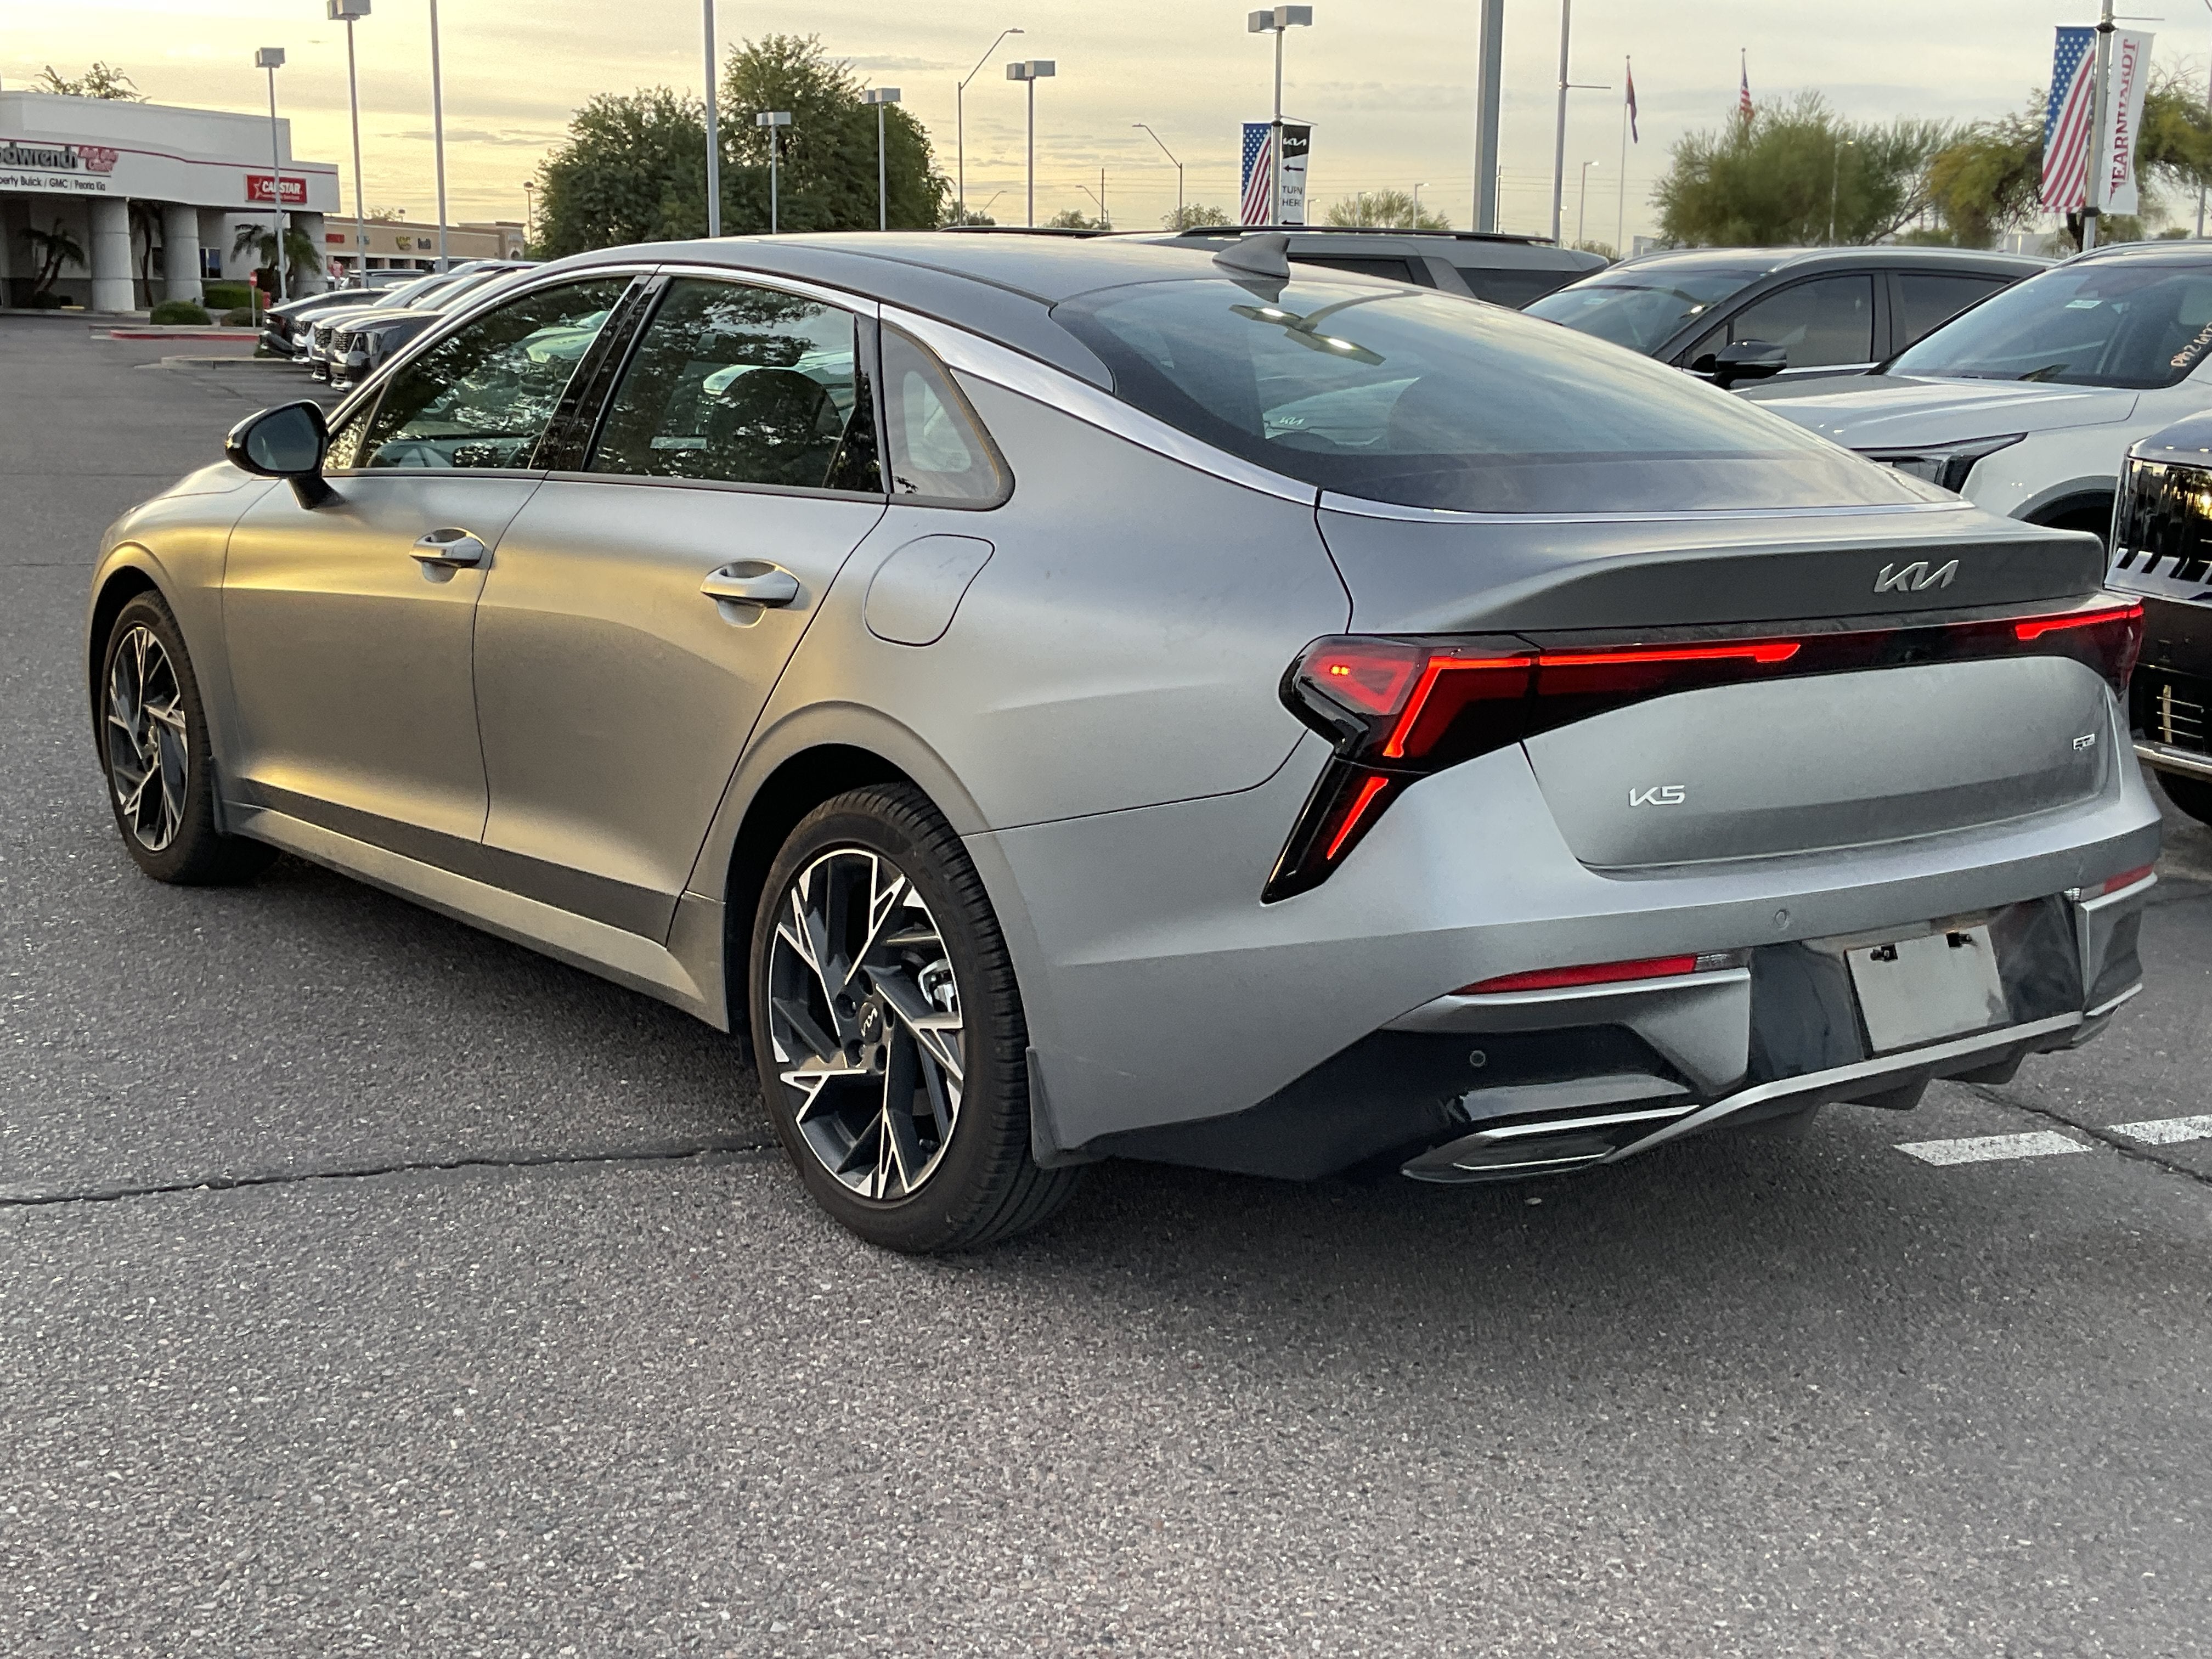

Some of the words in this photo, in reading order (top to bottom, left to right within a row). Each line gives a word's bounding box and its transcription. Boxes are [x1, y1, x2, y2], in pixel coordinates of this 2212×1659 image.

[49, 178, 68, 189] GMC
[262, 180, 301, 194] CASTAR
[1874, 560, 1959, 592] KIA
[1629, 785, 1685, 806] K5
